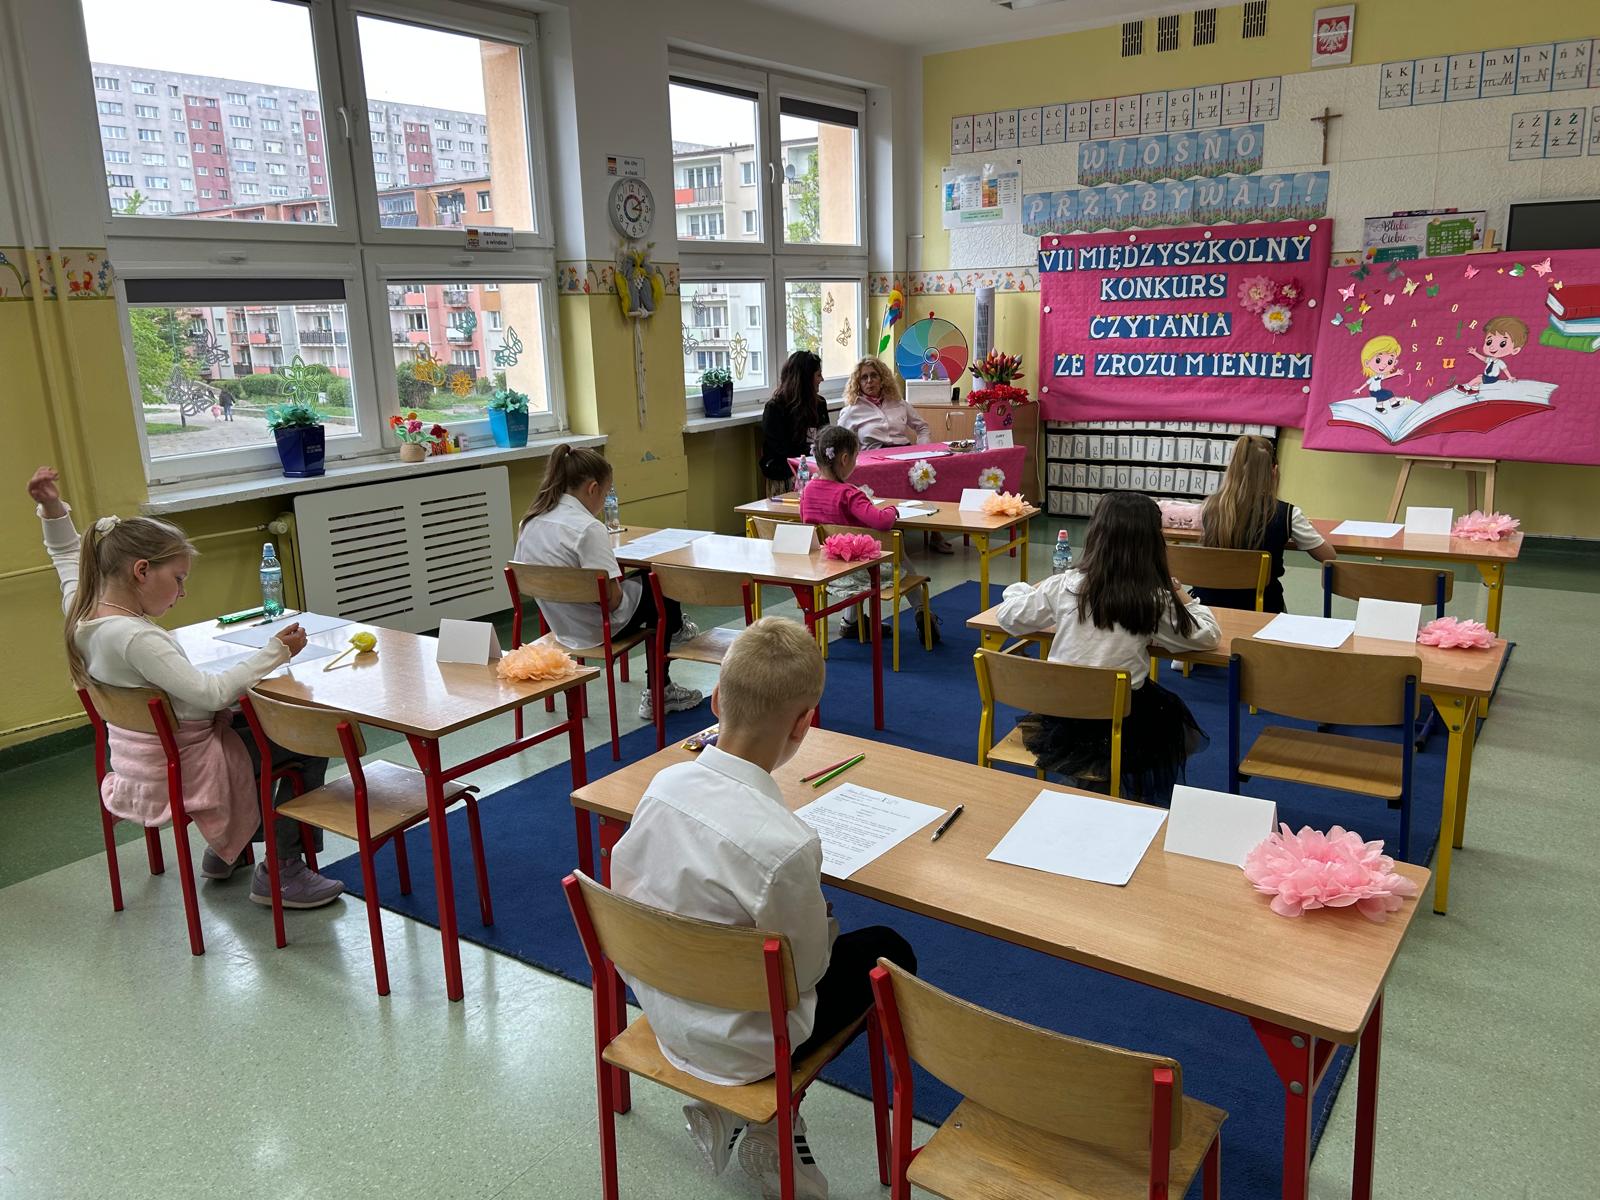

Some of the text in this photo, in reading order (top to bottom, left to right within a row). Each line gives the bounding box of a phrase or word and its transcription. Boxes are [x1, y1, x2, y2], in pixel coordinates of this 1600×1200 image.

[1082, 132, 1255, 170] WIOSNO
[626, 223, 629, 231] 7
[1040, 236, 1310, 272] VII MIĘDZYSZKOLNY
[1101, 274, 1226, 300] KONKURS
[1090, 314, 1230, 338] CZYTANIA
[1411, 318, 1417, 327] A
[1469, 320, 1477, 329] R
[1412, 344, 1417, 352] S
[1436, 337, 1443, 345] E
[1056, 354, 1312, 378] ZE ZROZUMIENIEM
[1076, 441, 1083, 453] G
[1093, 446, 1097, 458] g
[1106, 443, 1112, 454] H
[1122, 443, 1127, 455] h
[1152, 444, 1155, 456] i
[1166, 445, 1170, 456] J
[1184, 445, 1187, 460] j
[1195, 446, 1203, 457] K
[1214, 448, 1219, 459] k
[1090, 472, 1097, 482] N
[1119, 473, 1126, 484] O
[1135, 477, 1140, 486] o
[1150, 471, 1157, 486] Ó
[1164, 475, 1172, 487] P
[1179, 479, 1184, 488] p
[1194, 477, 1201, 488] R
